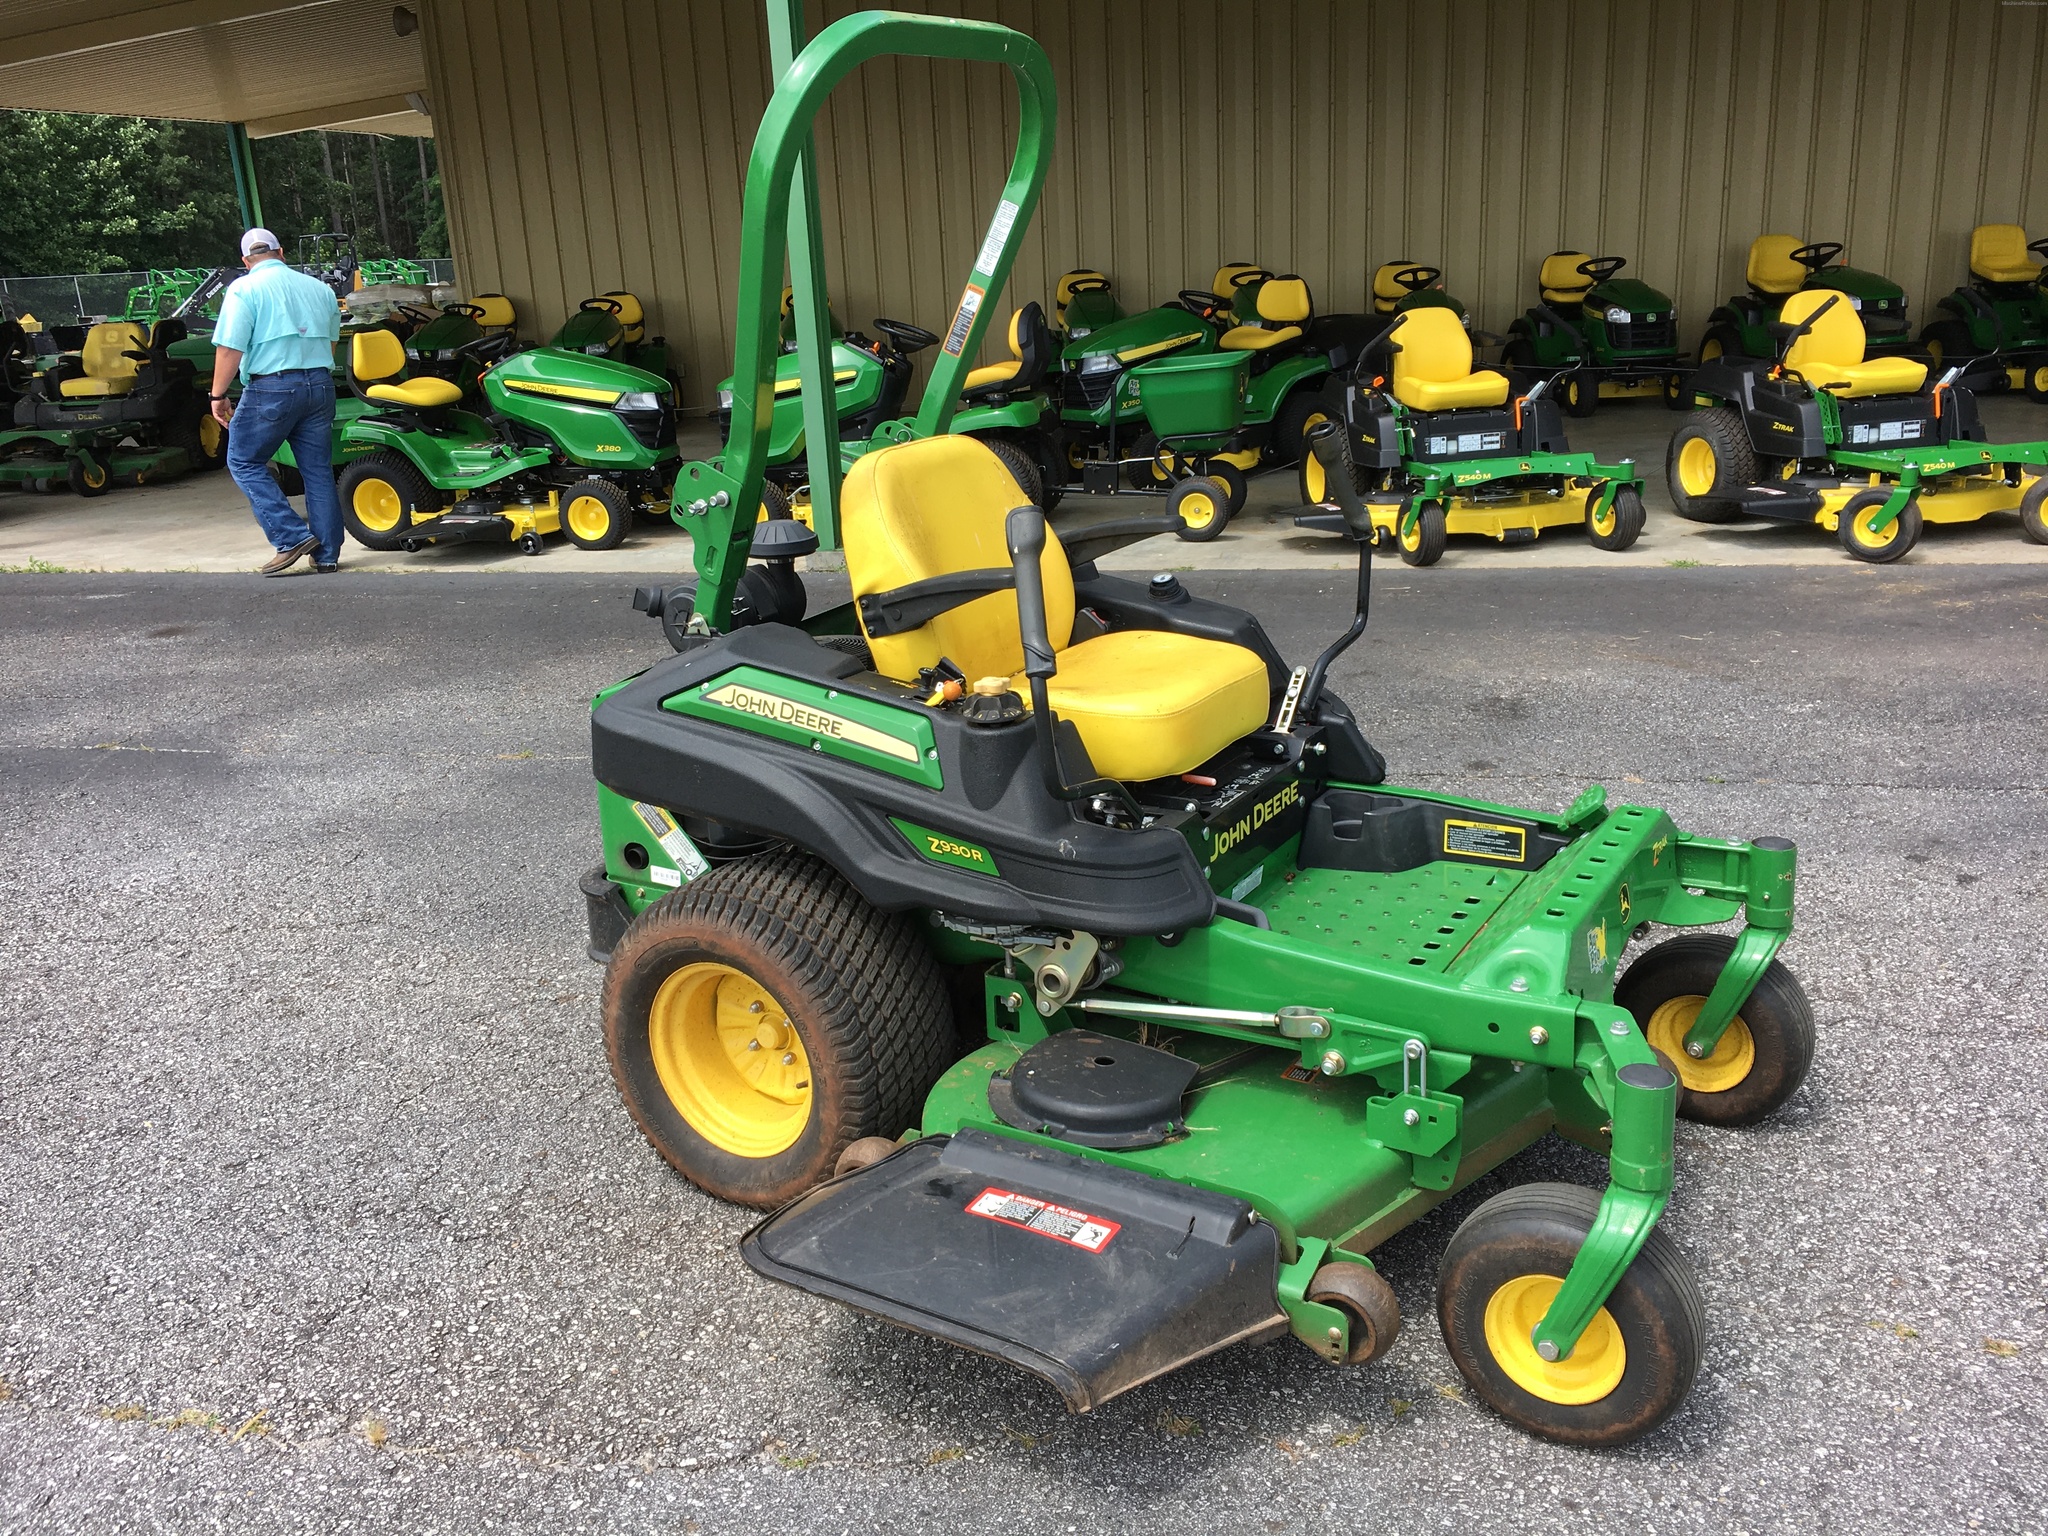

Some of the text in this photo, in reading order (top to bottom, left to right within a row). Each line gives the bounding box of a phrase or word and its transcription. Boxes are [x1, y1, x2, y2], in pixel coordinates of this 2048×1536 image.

[538, 385, 557, 393] DEERE
[596, 444, 621, 453] X380
[725, 688, 843, 736] JOHN DEERE
[1210, 815, 1250, 863] JOHN
[1253, 779, 1299, 830] DEERE
[1015, 1195, 1046, 1208] DANGER
[1055, 1206, 1088, 1220] PELIGRO
